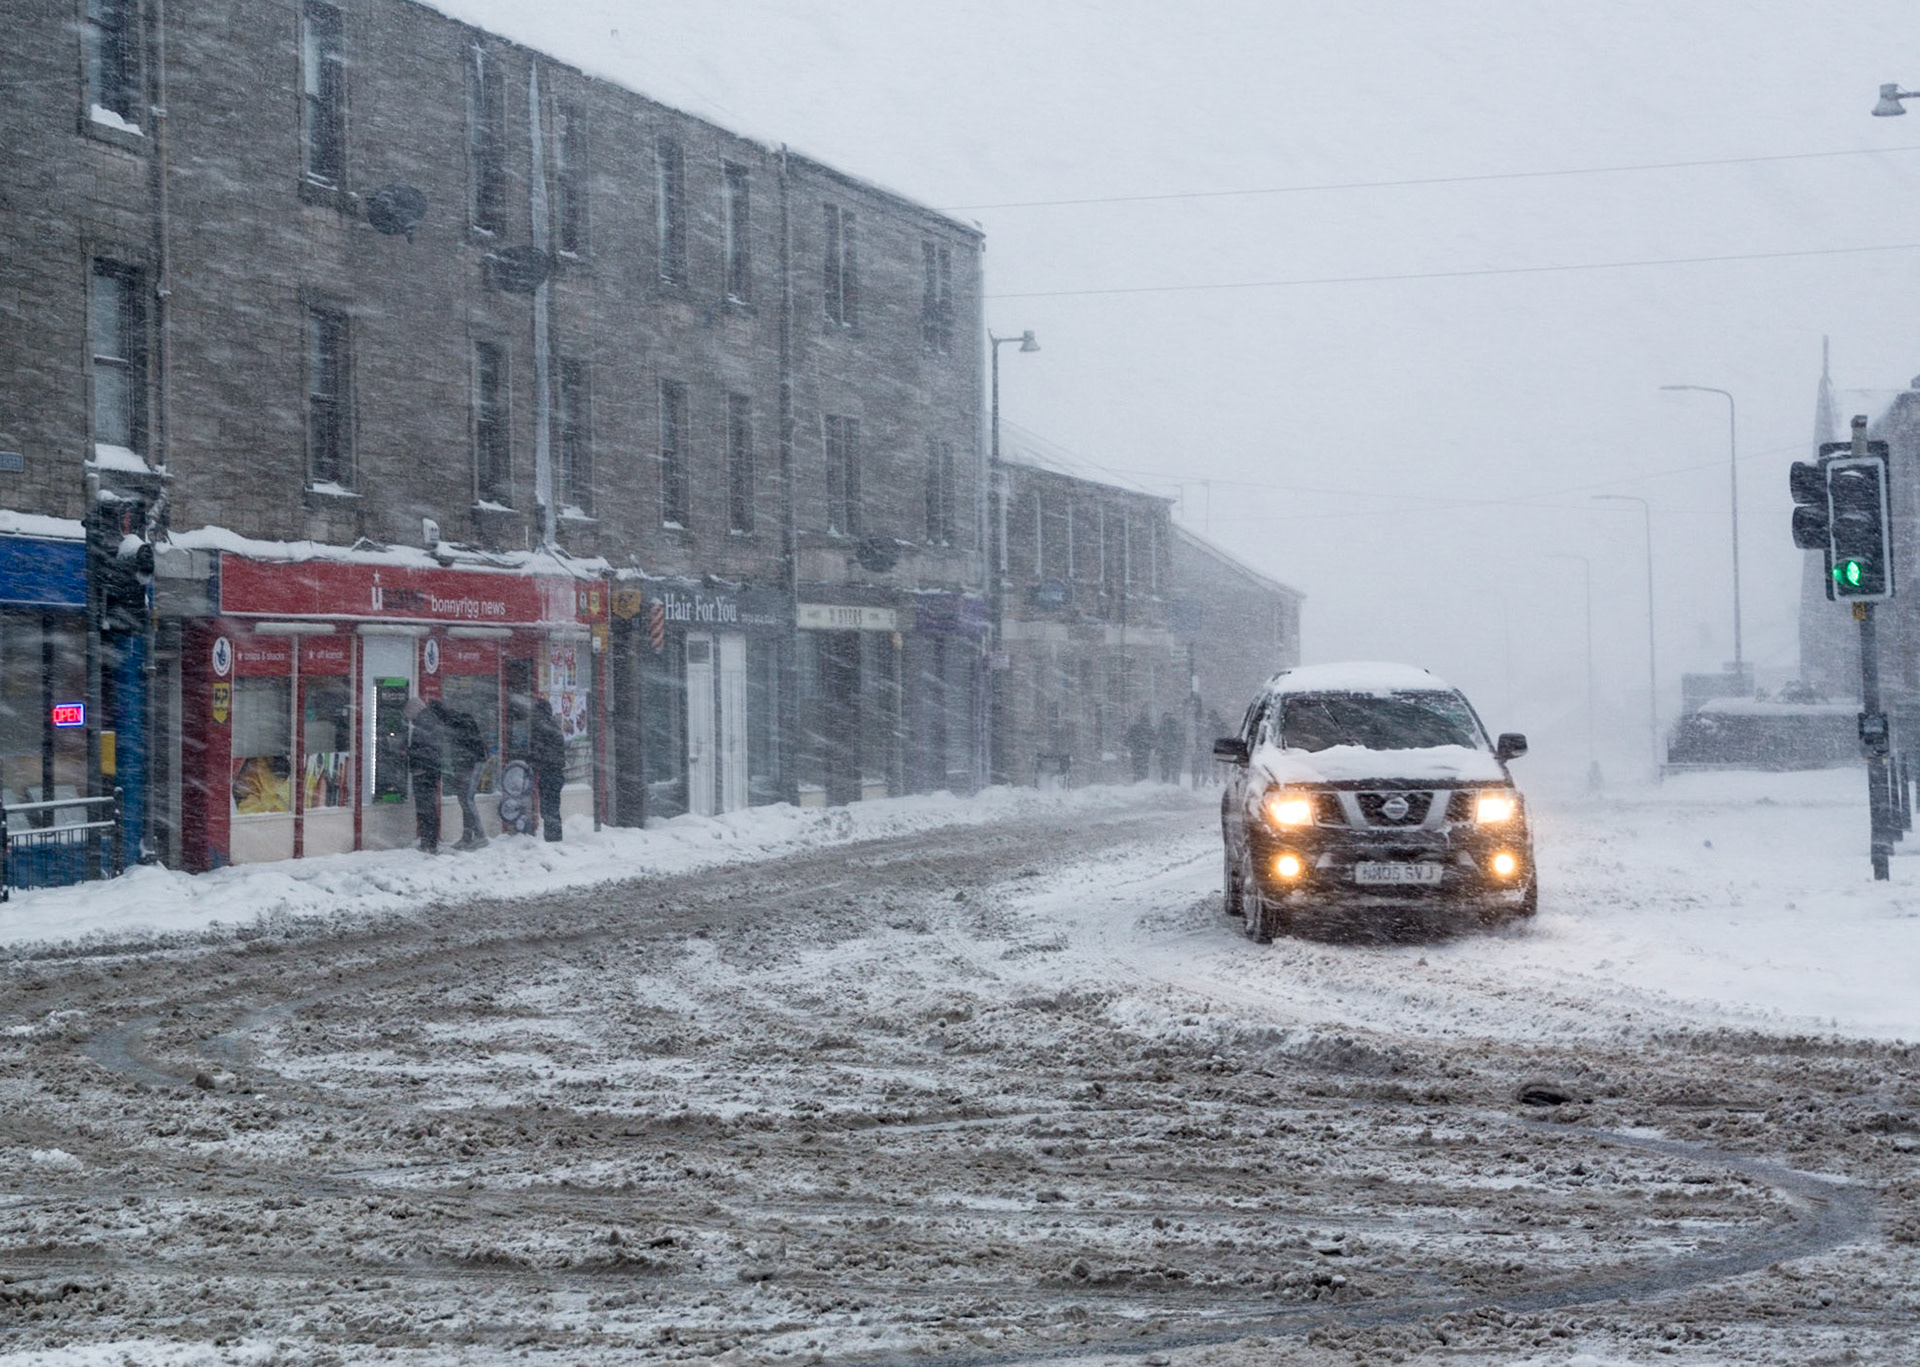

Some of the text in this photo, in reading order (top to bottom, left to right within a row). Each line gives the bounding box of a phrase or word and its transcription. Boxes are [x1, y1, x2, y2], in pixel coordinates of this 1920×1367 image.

[431, 593, 506, 618] bonnyrigg news
[664, 593, 692, 620] Hair
[695, 594, 714, 621] For
[716, 596, 737, 622] You
[52, 707, 81, 723] OPEN
